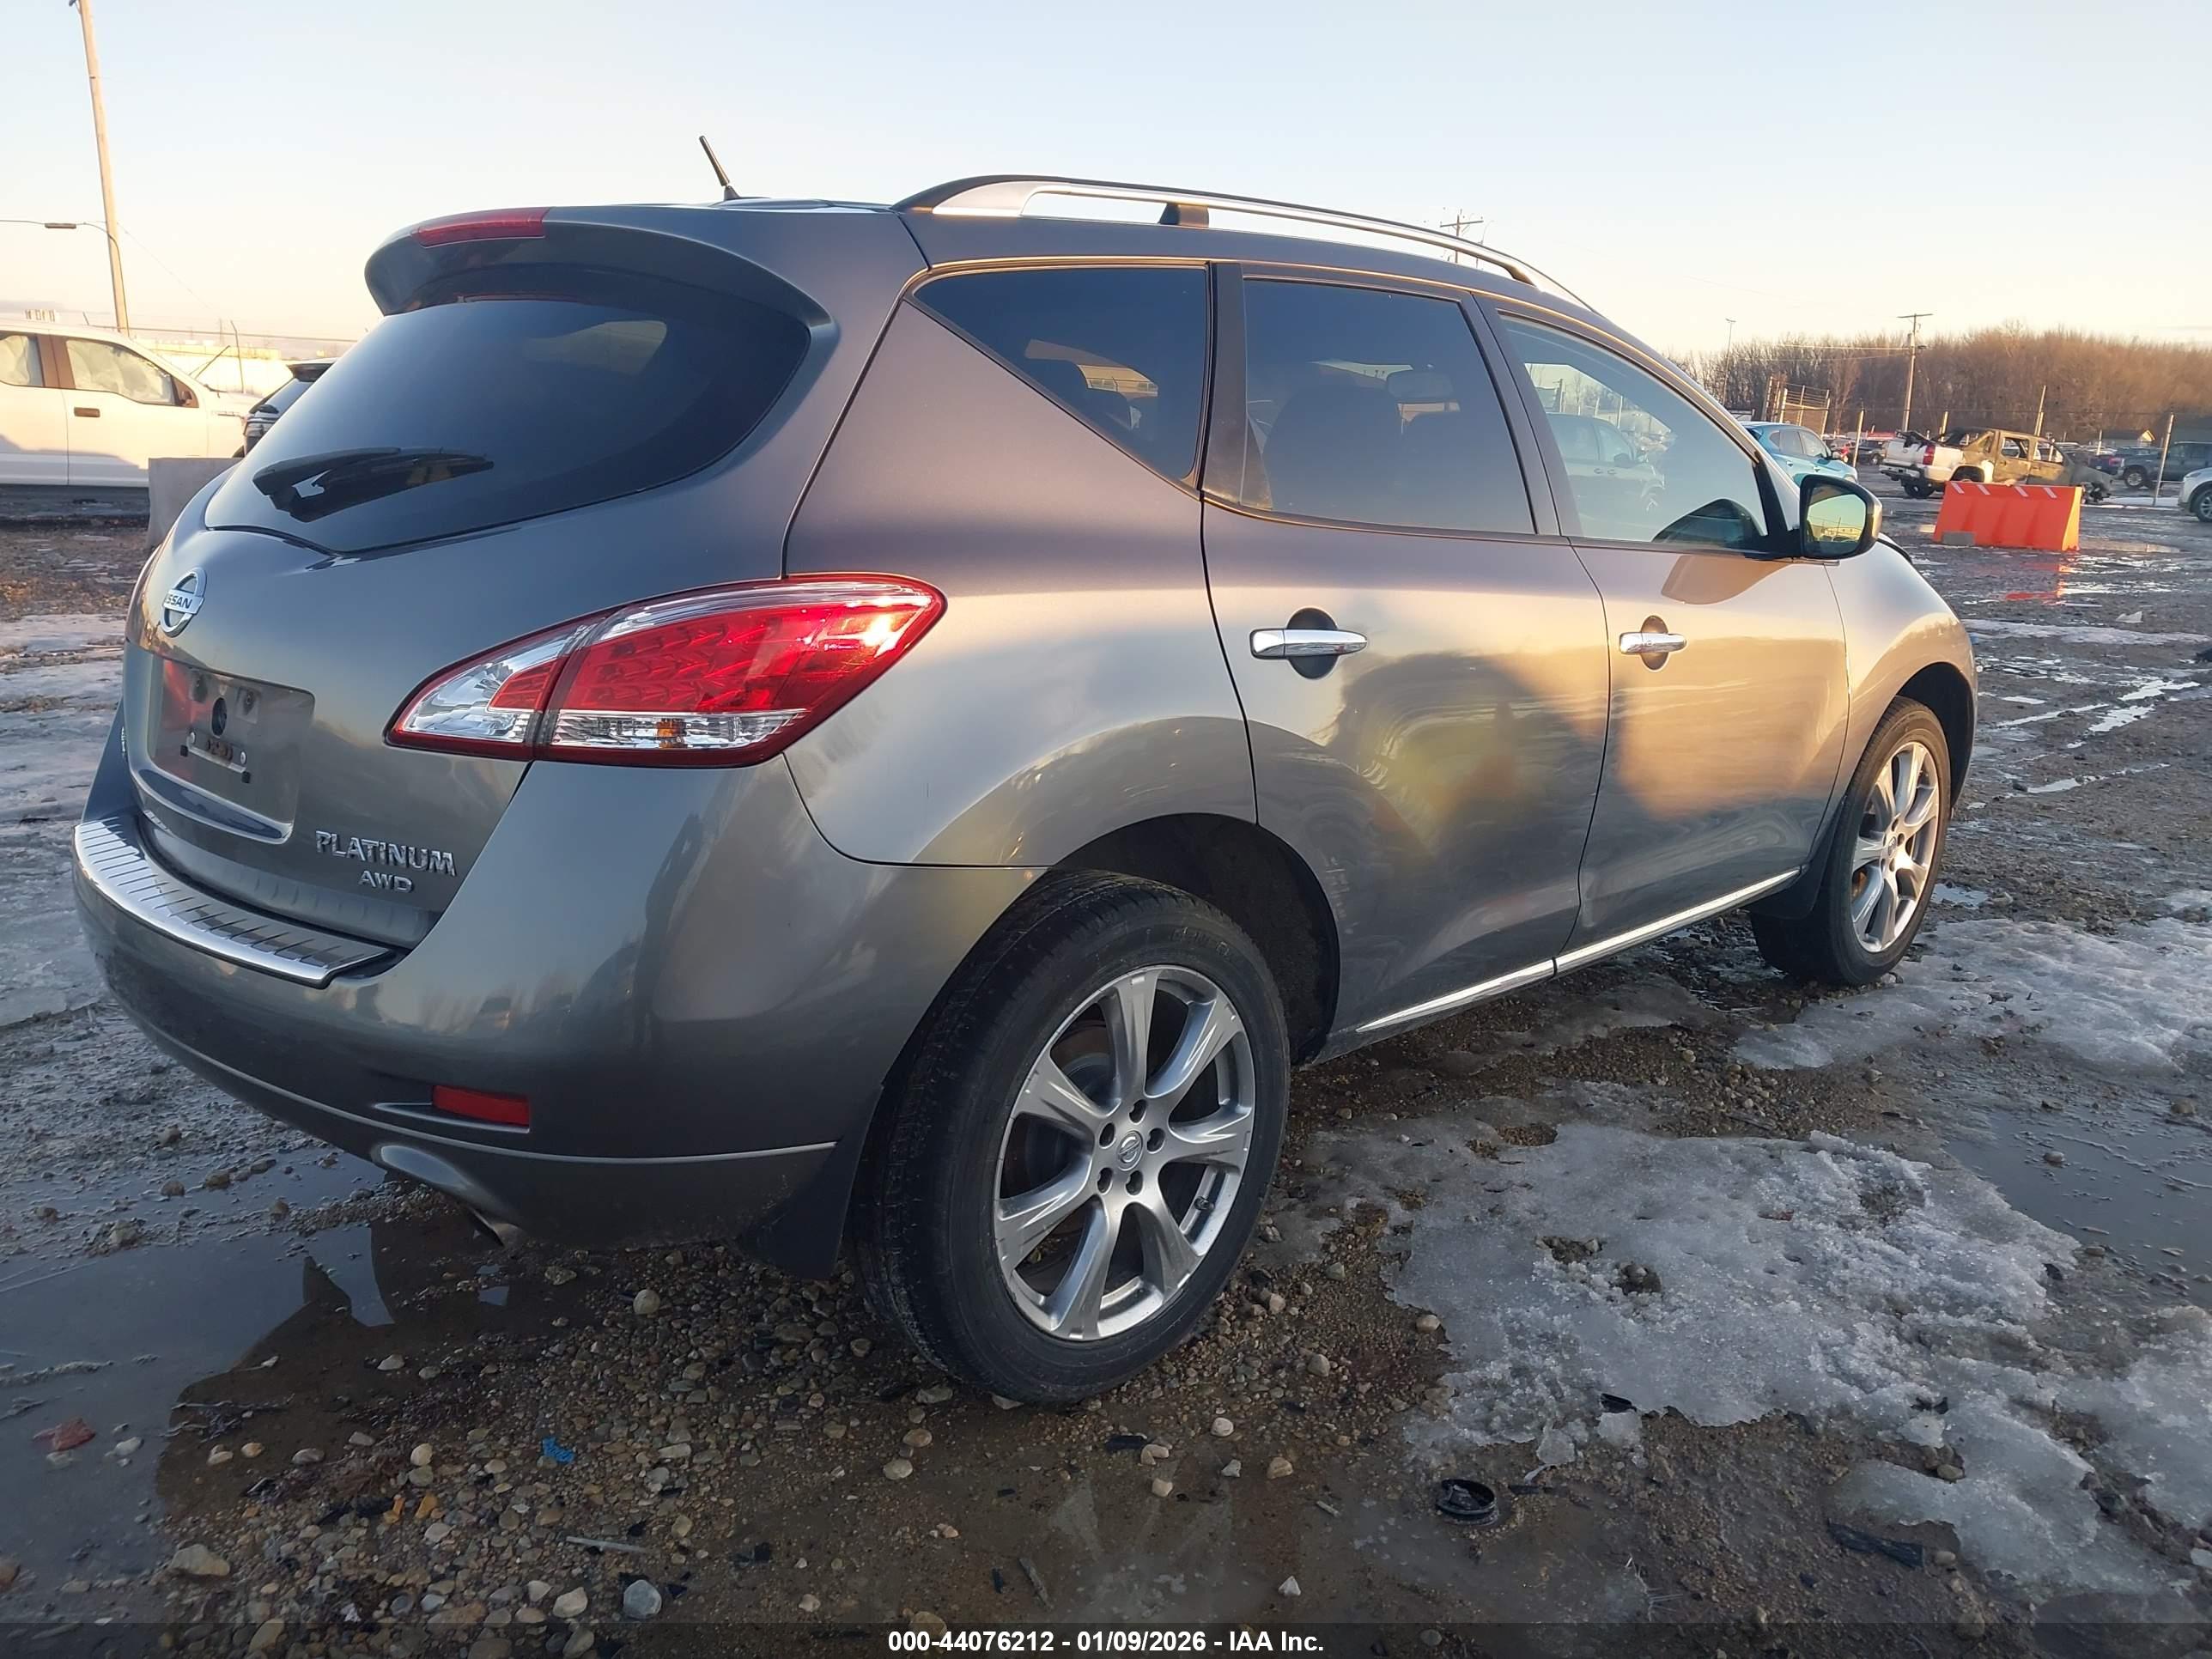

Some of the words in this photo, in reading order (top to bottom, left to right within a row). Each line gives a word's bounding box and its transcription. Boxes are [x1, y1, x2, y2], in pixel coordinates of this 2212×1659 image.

[164, 593, 193, 609] SSAN
[315, 830, 457, 877] PLATINUM
[359, 870, 413, 893] AWD
